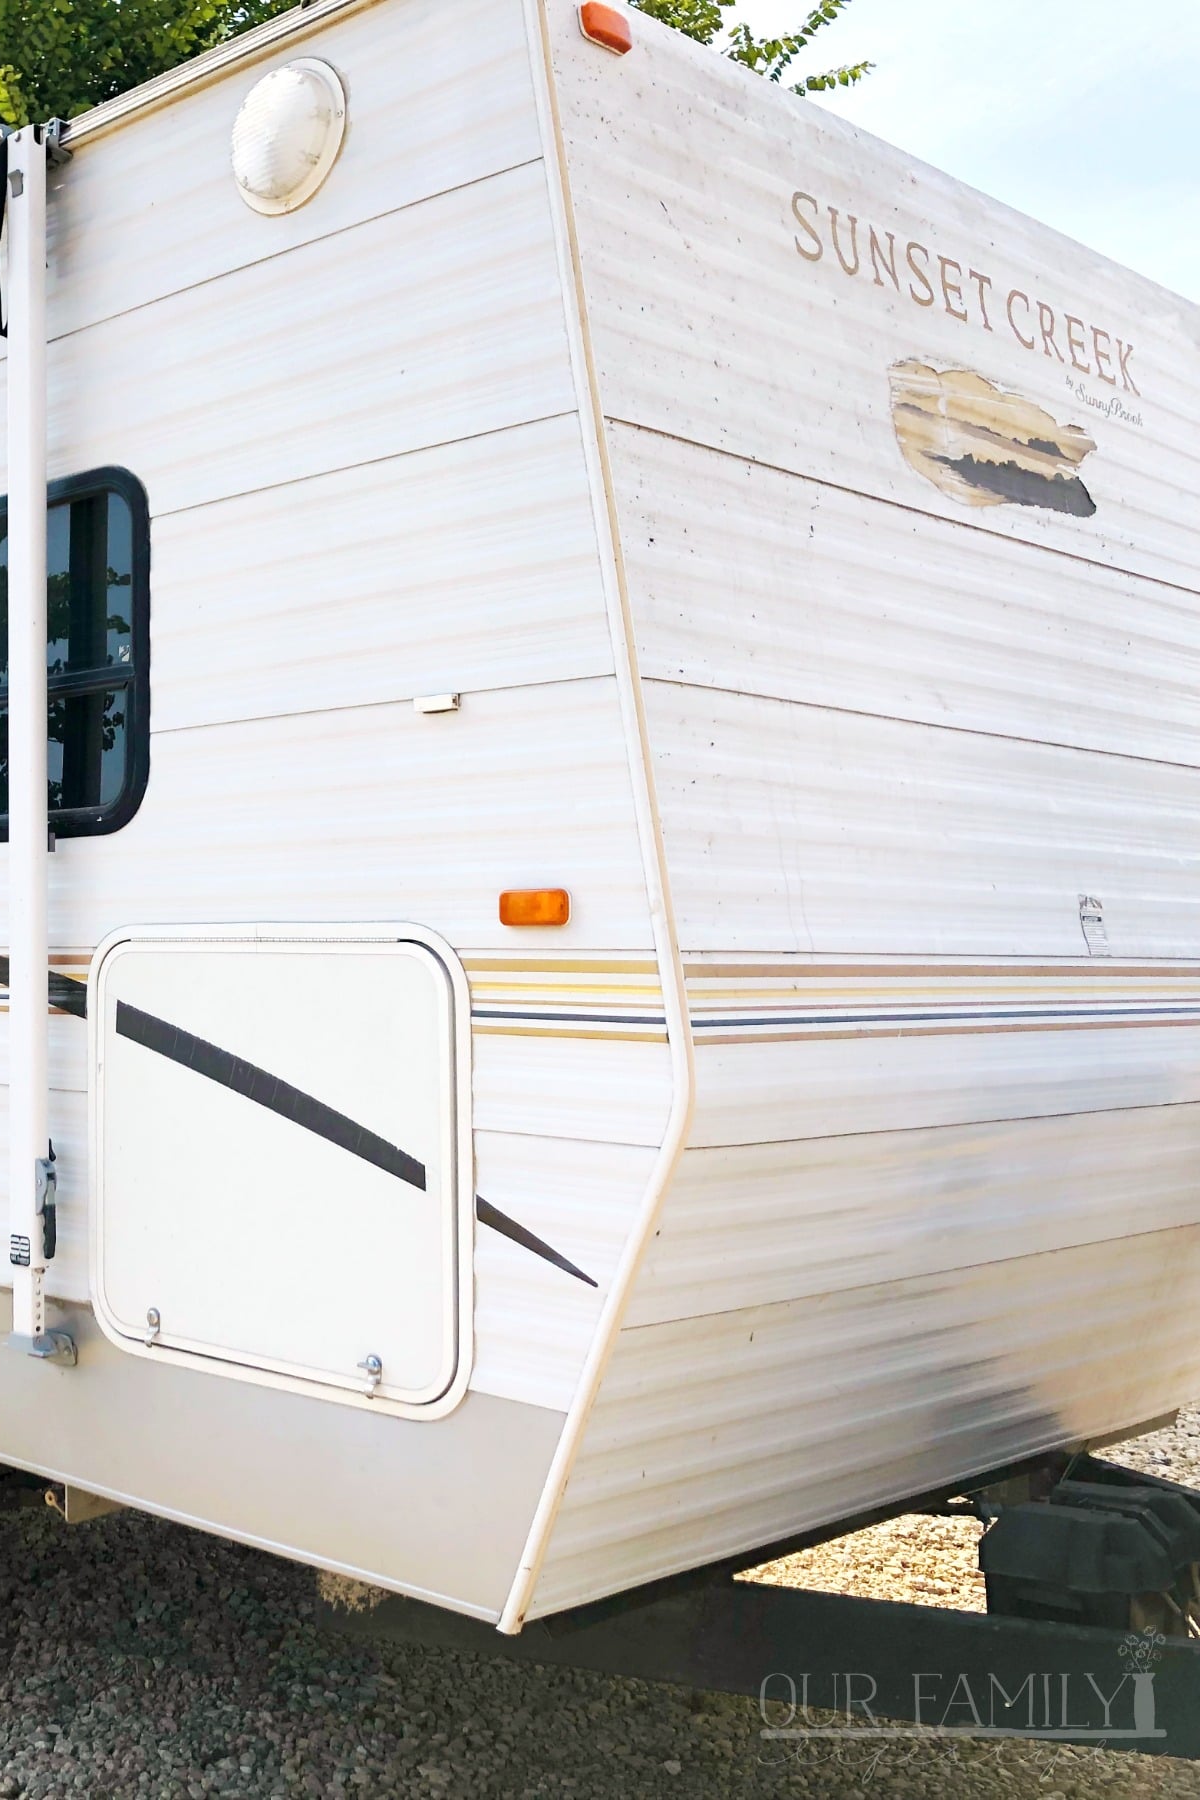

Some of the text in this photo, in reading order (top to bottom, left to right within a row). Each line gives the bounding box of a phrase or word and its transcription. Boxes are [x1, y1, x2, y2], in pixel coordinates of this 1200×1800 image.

[791, 191, 1141, 396] SUNSET CREEK
[1075, 383, 1144, 427] SunnyBrook
